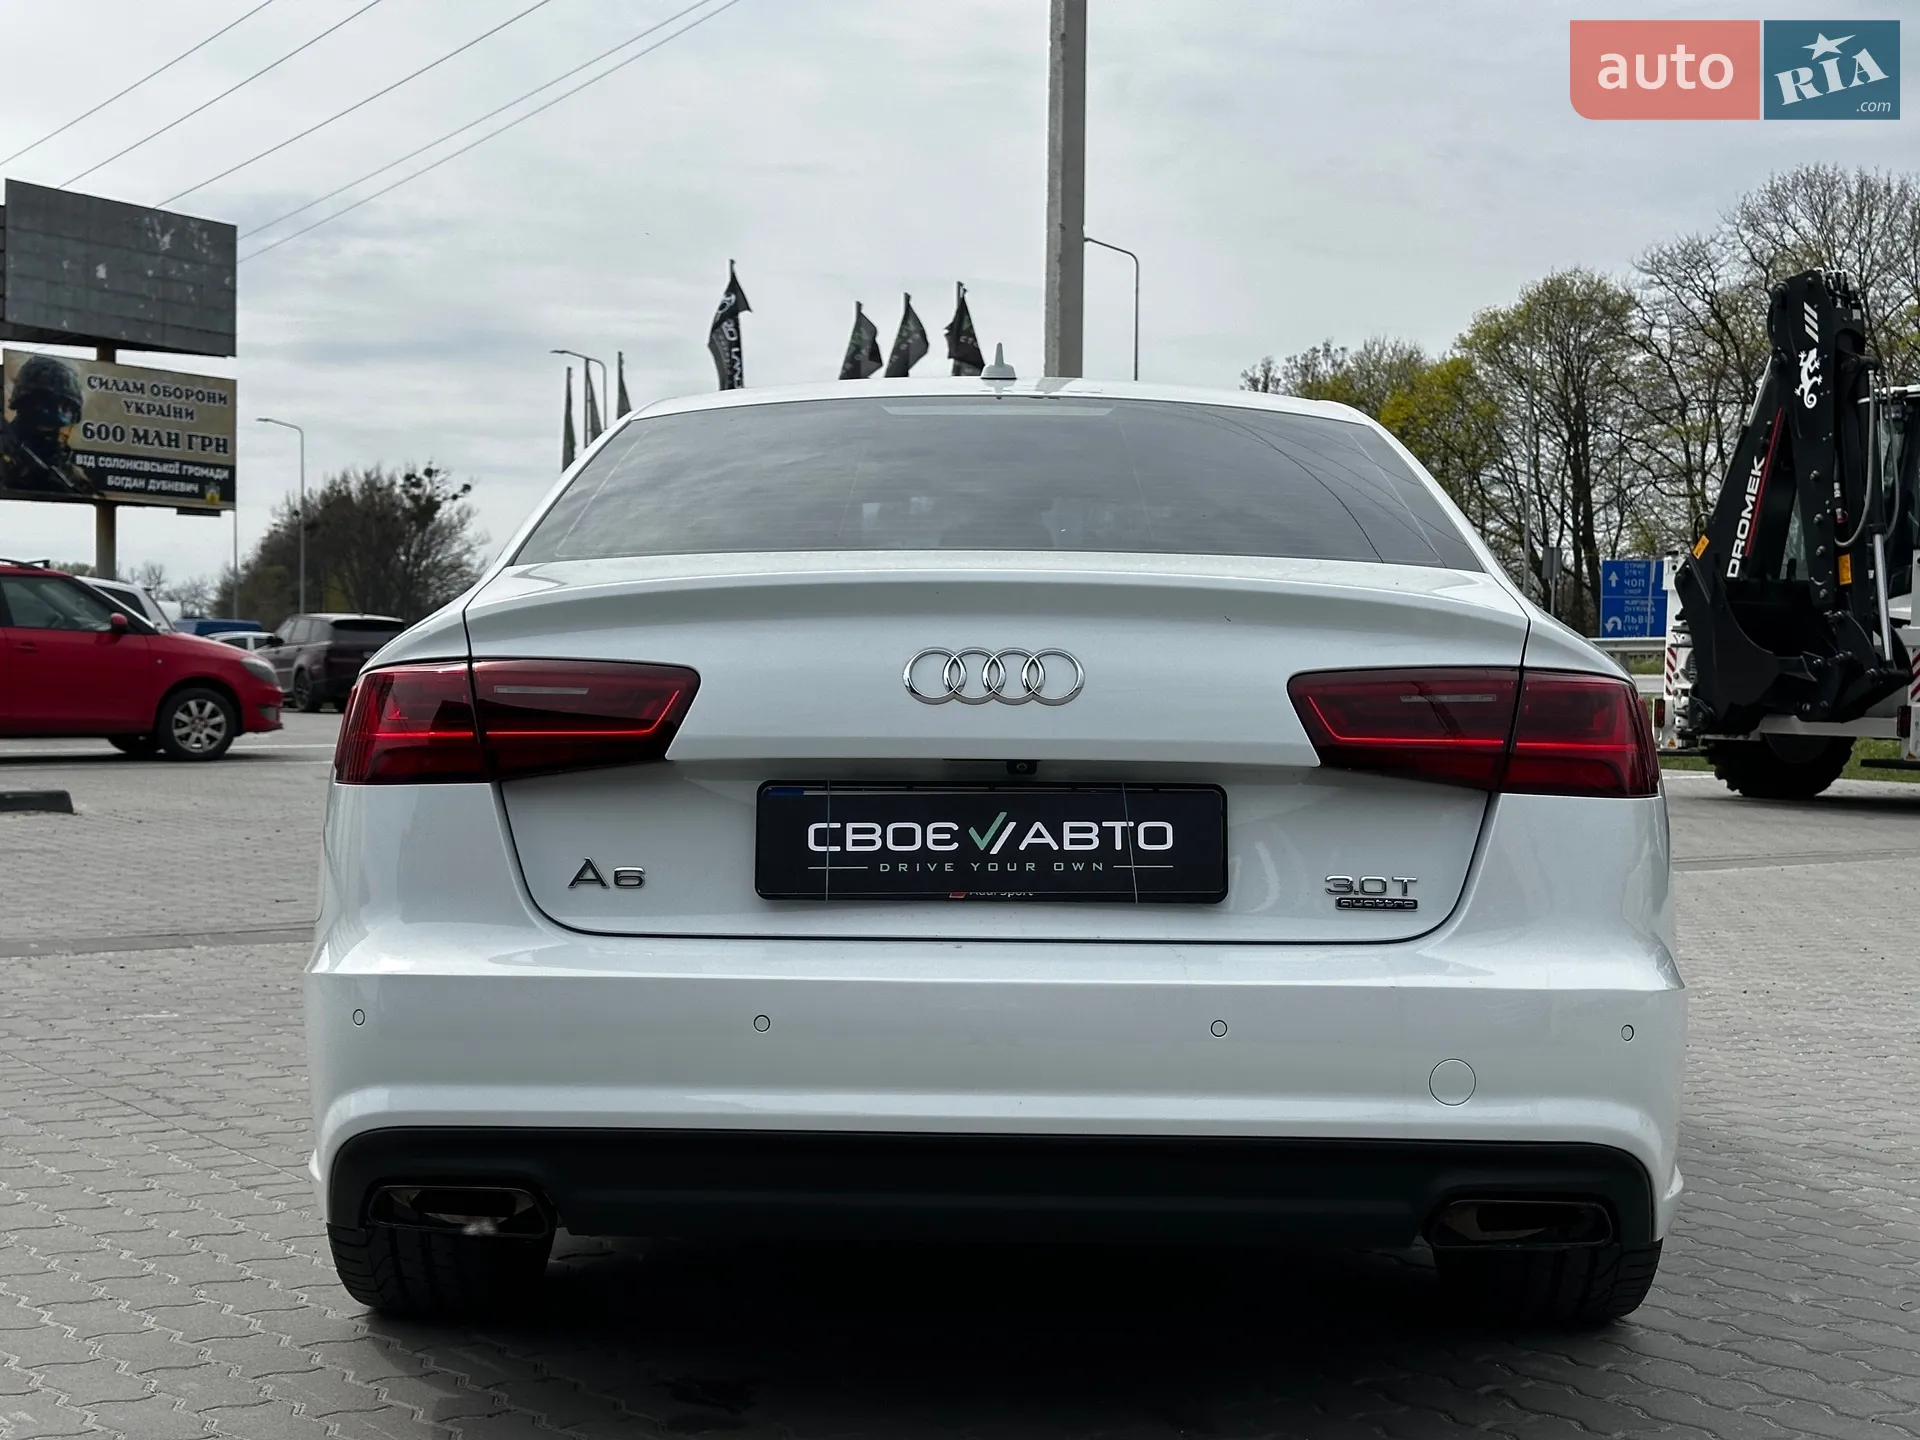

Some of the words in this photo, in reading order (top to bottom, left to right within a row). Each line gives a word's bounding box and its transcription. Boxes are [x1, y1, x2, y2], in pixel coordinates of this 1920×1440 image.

[87, 376, 145, 395] СИЛАМ
[150, 384, 228, 405] ОБОРОНИ
[123, 400, 195, 420] УКРАЇНИ
[82, 423, 126, 442] 600
[131, 427, 181, 449] МЛН
[186, 434, 229, 454] ГРН
[75, 453, 96, 468] ВІД
[98, 455, 180, 475] СОЛОНКІВСЬКОЇ
[182, 464, 230, 480] ГРОМАДИ
[107, 475, 146, 490] БОГДАН
[147, 478, 199, 494] ДУБНЕВИЧ
[1727, 455, 1766, 579] DROMEK
[1624, 578, 1645, 588] ЧОП
[1018, 820, 1175, 852] АВТО
[567, 855, 646, 890] A6
[879, 862, 955, 872] DRIVE
[969, 861, 1036, 872] YOUR
[1053, 861, 1104, 872] OWN
[1340, 899, 1416, 908] quattro
